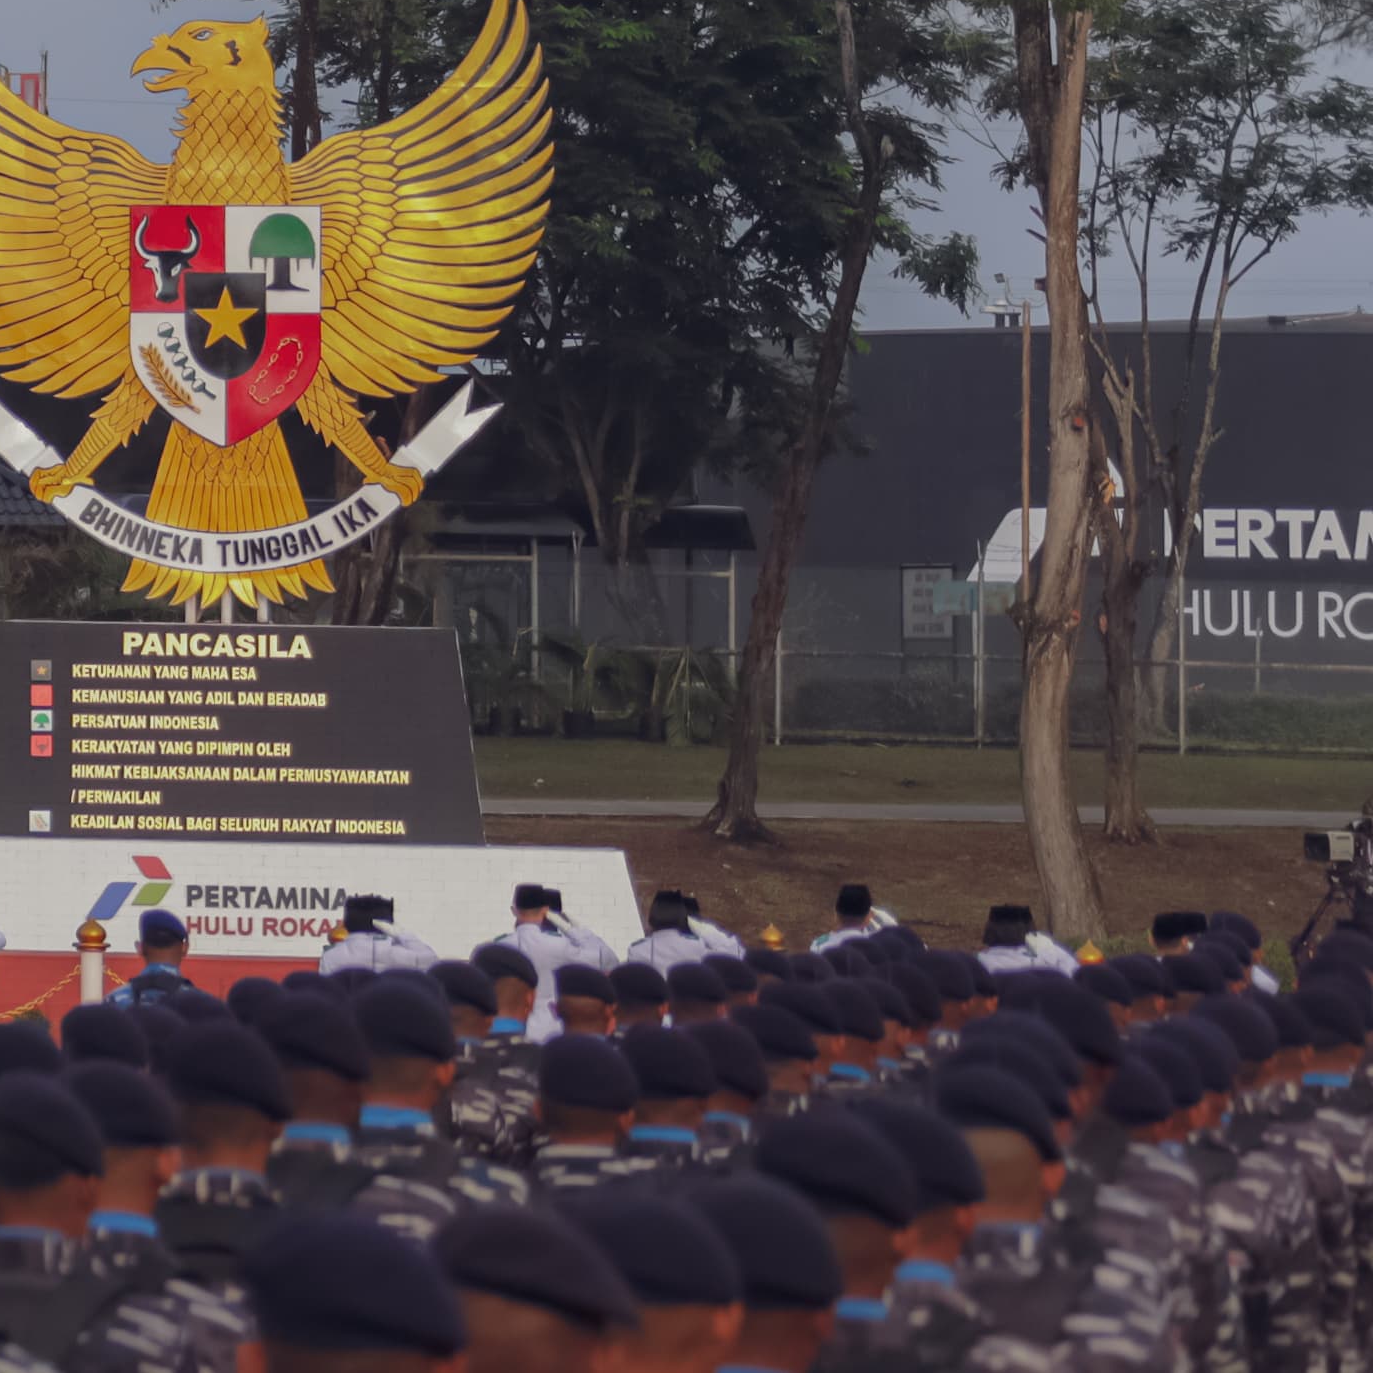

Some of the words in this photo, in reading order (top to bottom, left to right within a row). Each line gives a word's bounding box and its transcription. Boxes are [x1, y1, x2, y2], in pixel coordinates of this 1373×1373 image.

[79, 497, 203, 565] BHINNEKA
[216, 524, 334, 567] TUNGGAL
[332, 497, 379, 538] IKA
[122, 631, 313, 659] PANCASILA
[72, 663, 151, 679] KETUHANAN
[154, 665, 189, 680] YANG
[192, 666, 229, 681] MAHA
[232, 667, 257, 681] ESA
[72, 689, 165, 704] KEMANUSIAAN
[168, 690, 203, 705] YANG
[205, 691, 235, 706] ADIL
[238, 692, 264, 706] DAN
[267, 692, 327, 707] BERADAB
[72, 714, 147, 729] PERSATUAN
[149, 715, 220, 730] INDONESIA
[72, 739, 155, 755] KERAKYATAN
[158, 740, 193, 755] YANG
[196, 741, 254, 756] DIPIMPIN
[256, 742, 291, 757] OLEH
[71, 764, 121, 779] HIKMAT
[123, 765, 230, 781] KEBIJAKSANAAN
[233, 767, 277, 782] DALAM
[279, 768, 410, 785] PERMUSYAWARATAN
[70, 789, 76, 804] /
[78, 789, 162, 805] PERWAKILAN
[71, 814, 134, 829] KEADILAN
[137, 815, 183, 831] SOSIAL
[186, 817, 217, 832] BAGI
[220, 817, 279, 833] SELURUH
[282, 819, 333, 834] RAKYAT
[335, 819, 406, 835] INDONESIA
[186, 884, 347, 910] PERTAMINA
[186, 915, 254, 936] HULU
[262, 916, 345, 937] ROKA
